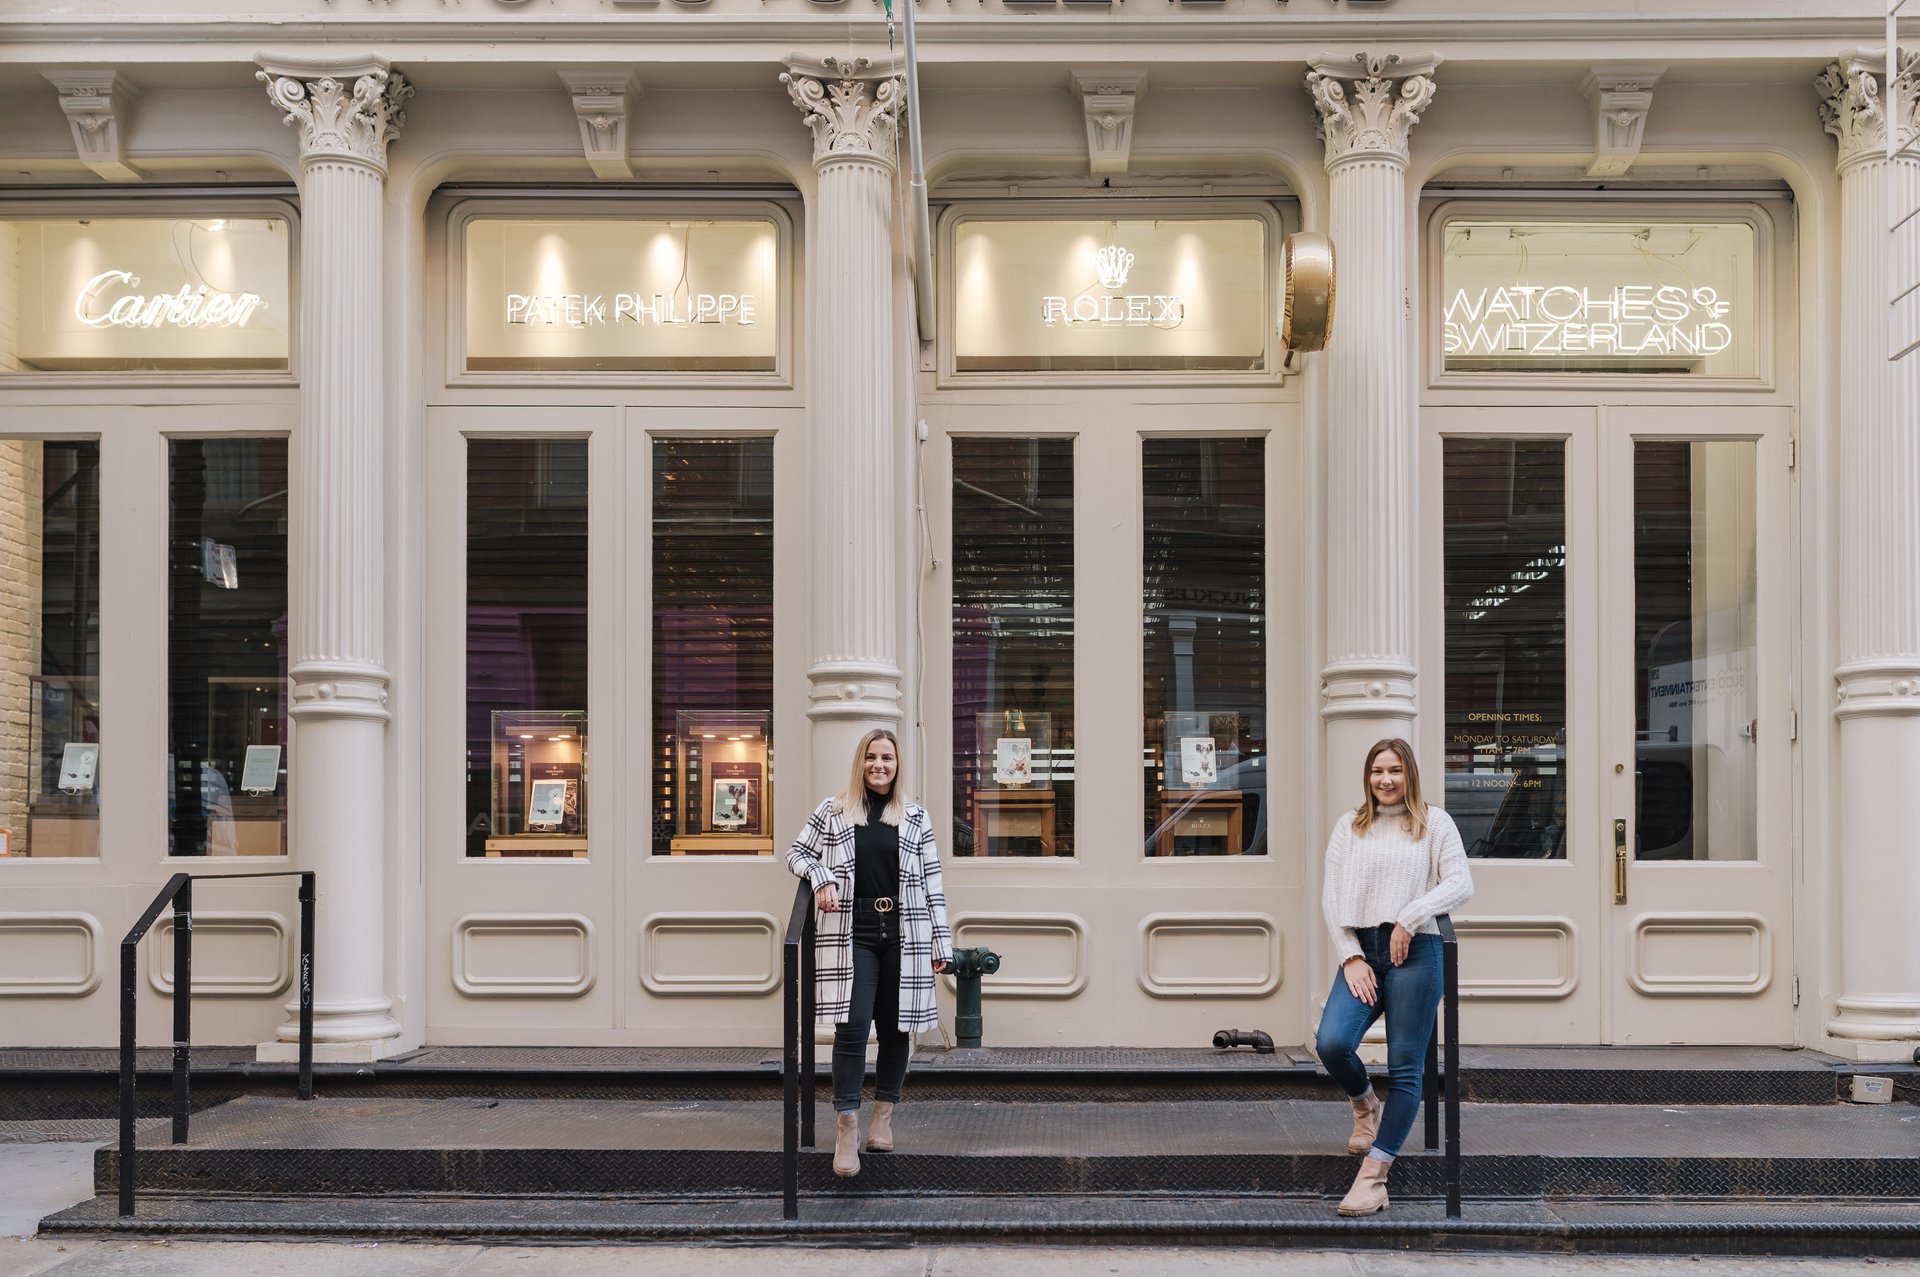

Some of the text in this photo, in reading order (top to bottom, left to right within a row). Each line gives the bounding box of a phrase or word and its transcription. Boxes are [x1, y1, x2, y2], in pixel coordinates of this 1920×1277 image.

[75, 270, 261, 325] Cartier
[507, 294, 756, 325] PATEK PHILIPPE
[1042, 295, 1184, 322] ROLEX
[1444, 286, 1690, 321] WATCHES
[1444, 322, 1732, 352] SWITZERLAND
[1468, 713, 1542, 722] OPENING TIMES:
[1454, 735, 1556, 744] MONDAY TO SATURDAY
[1513, 747, 1531, 755] 7PM
[1471, 779, 1481, 788] 12
[1523, 780, 1541, 788] 6PM
